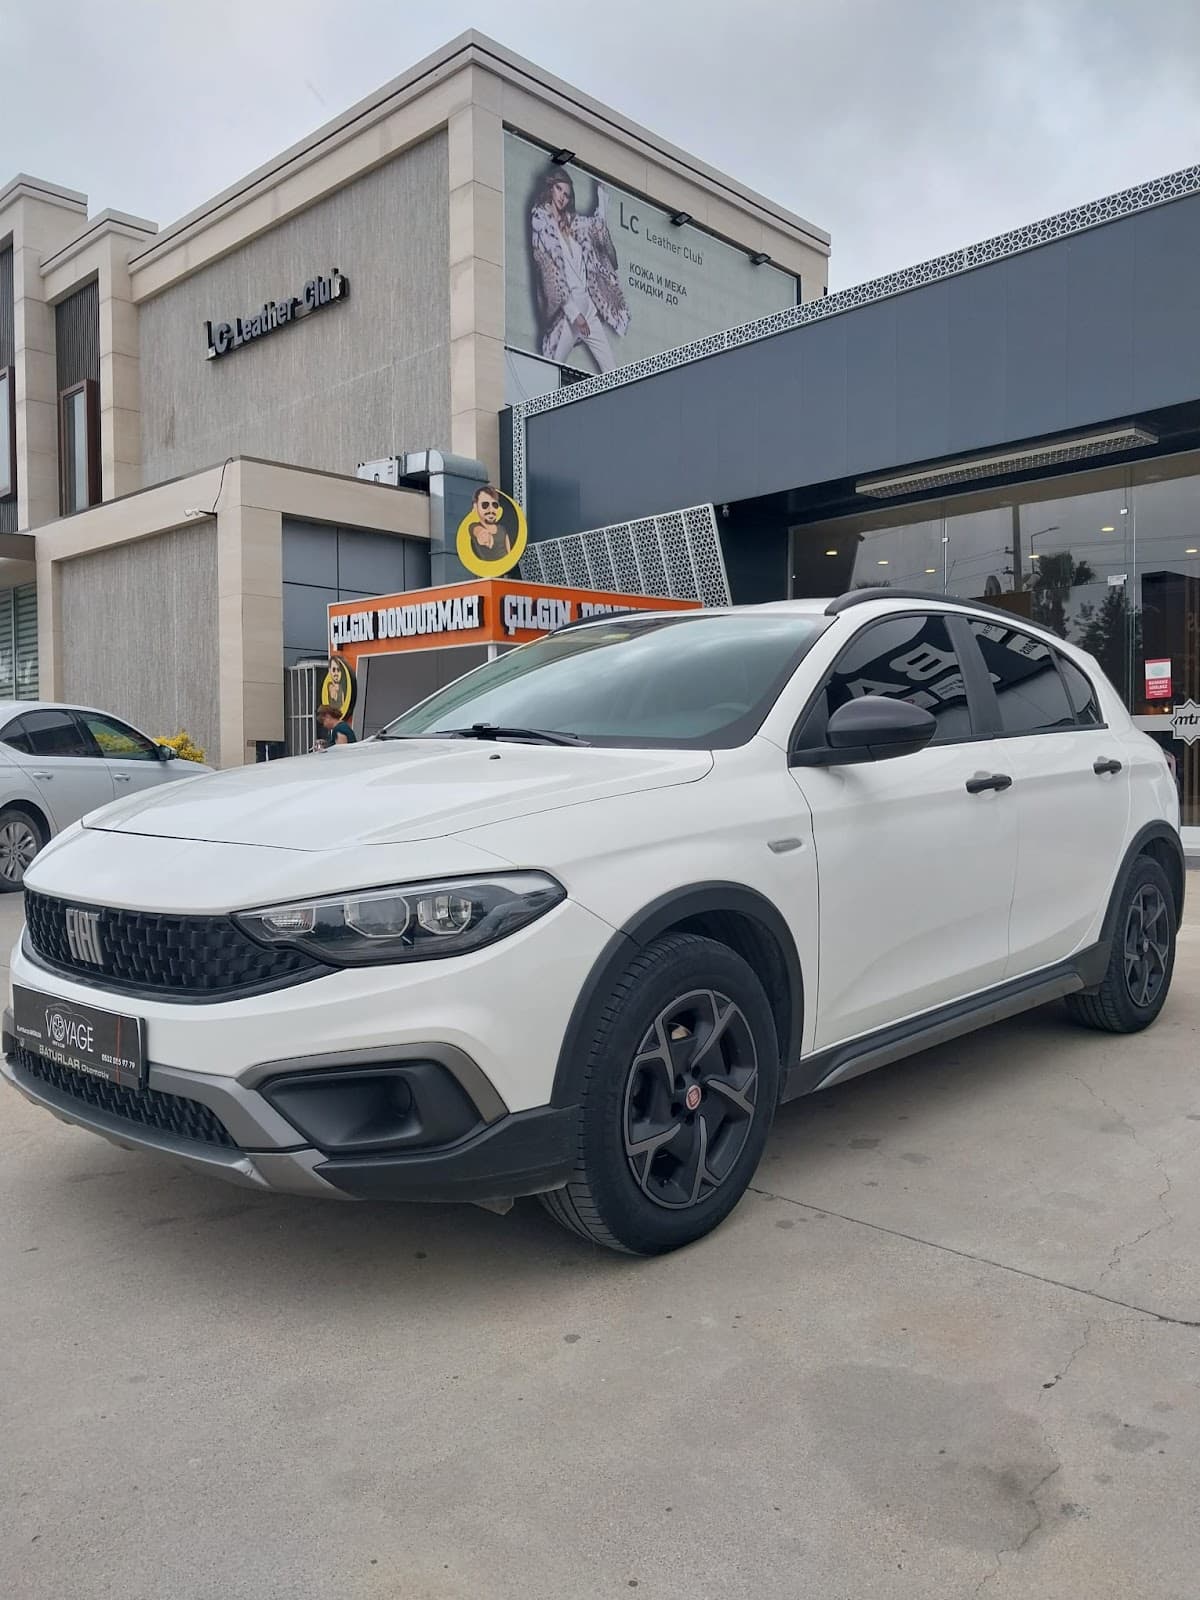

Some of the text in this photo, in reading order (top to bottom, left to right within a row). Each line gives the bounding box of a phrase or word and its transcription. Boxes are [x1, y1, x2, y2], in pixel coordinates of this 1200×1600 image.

[646, 228, 680, 255] Leather
[683, 246, 703, 266] Club
[628, 276, 679, 306] СКИДКИ ДО
[629, 262, 688, 297] КОЖА И МЕХА
[331, 595, 481, 651] ÇILGIN DONDURMACI
[504, 594, 571, 635] ÇILGIN
[65, 908, 104, 966] FIAT
[45, 1009, 94, 1052] VOYAGE
[39, 1044, 80, 1071] BATURLAR
